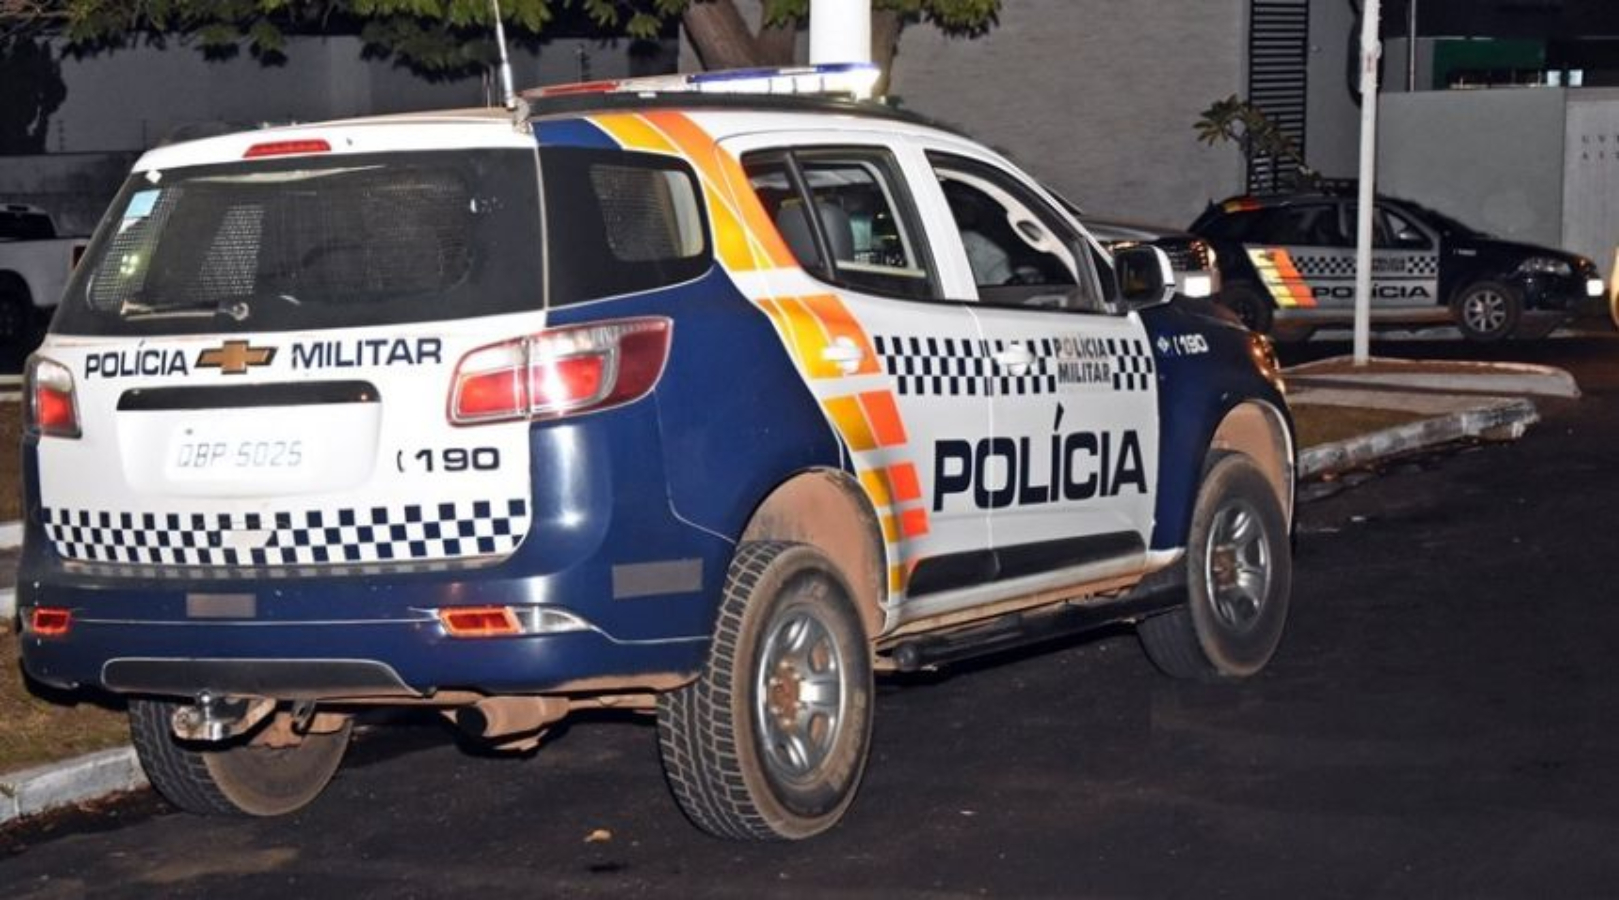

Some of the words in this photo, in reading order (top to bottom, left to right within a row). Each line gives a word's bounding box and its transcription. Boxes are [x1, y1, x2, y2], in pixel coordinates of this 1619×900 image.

[1311, 284, 1430, 298] POÍCIA
[1053, 334, 1107, 358] POLÍCIA
[1180, 334, 1209, 354] 190
[85, 340, 188, 379] POLÍCIA
[292, 338, 442, 369] MILITAR
[1058, 362, 1110, 383] MILITAR
[236, 440, 302, 467] 5025
[933, 402, 1147, 511] POLÍCIA
